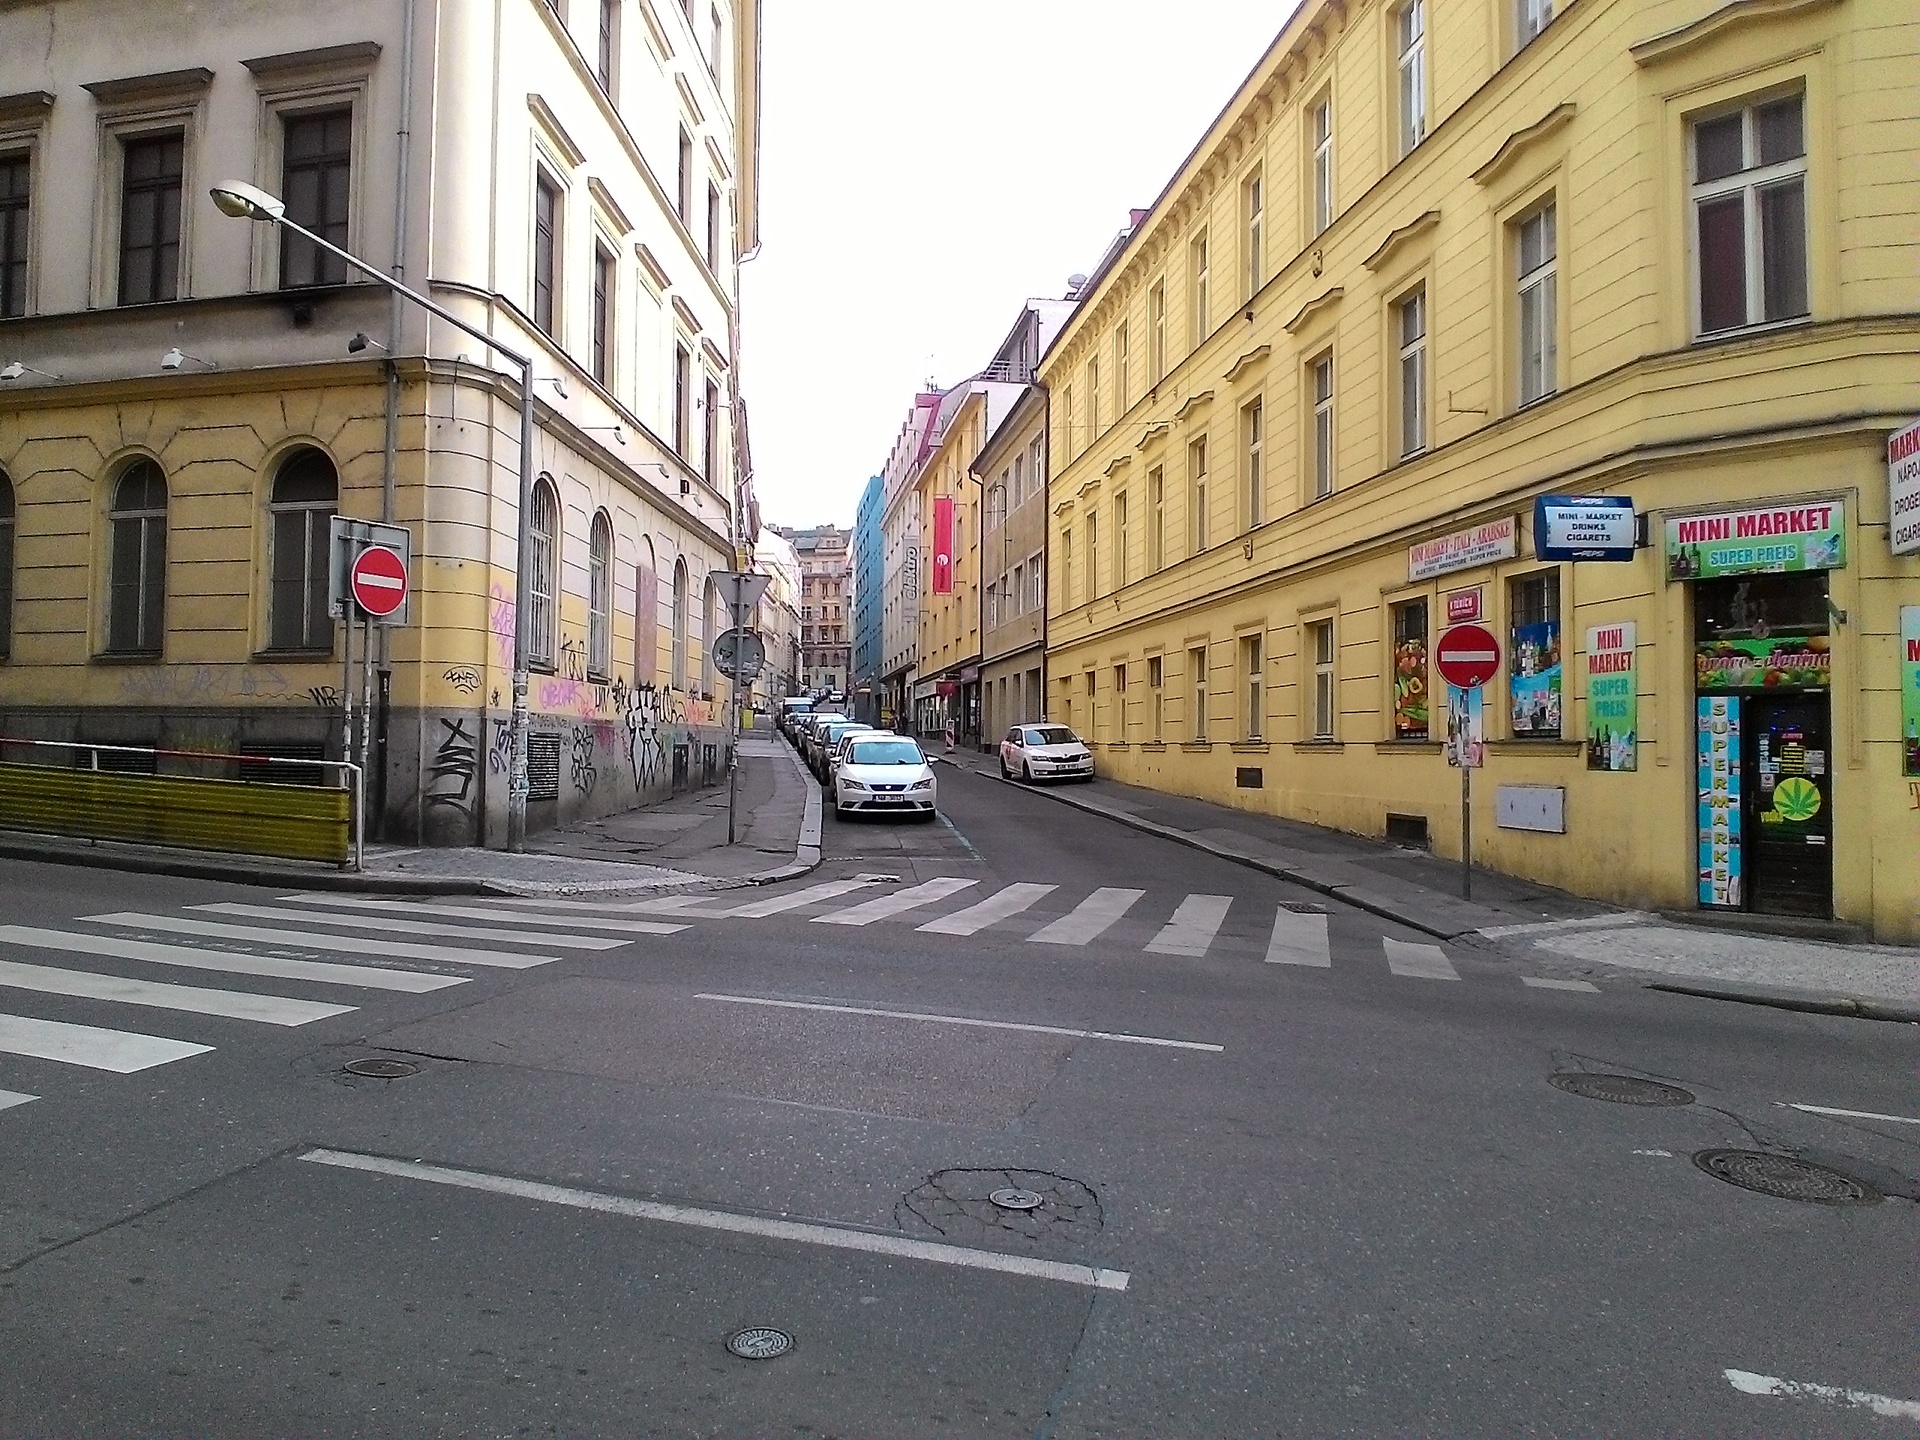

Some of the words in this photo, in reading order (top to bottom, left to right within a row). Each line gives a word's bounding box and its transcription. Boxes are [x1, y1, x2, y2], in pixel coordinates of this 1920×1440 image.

[1572, 523, 1606, 531] DRINKS
[1679, 517, 1730, 543] MINI
[1737, 507, 1832, 538] MARKET
[1711, 548, 1753, 566] SUPER
[1757, 545, 1797, 562] PREIS
[902, 546, 918, 600] elektro
[1597, 629, 1623, 650] MINI
[1589, 651, 1633, 674] MARKET
[1592, 678, 1629, 696] SUPER
[1595, 699, 1627, 717] PREIS
[1712, 703, 1729, 899] SUPERMARKET
